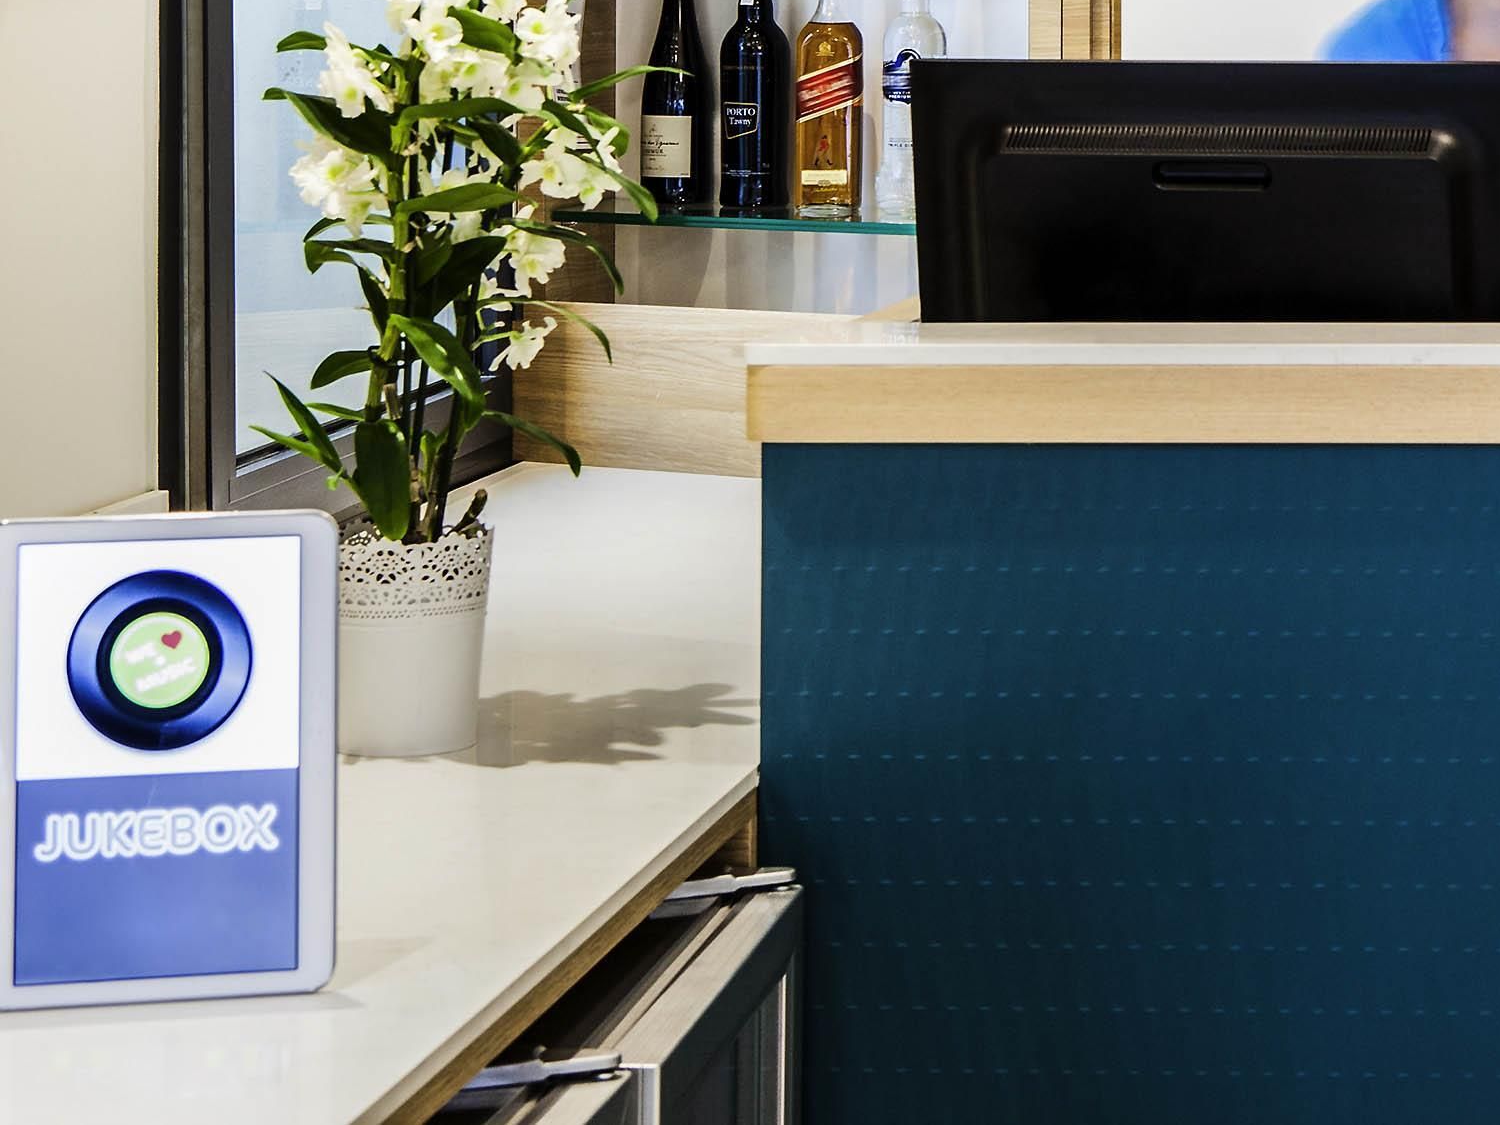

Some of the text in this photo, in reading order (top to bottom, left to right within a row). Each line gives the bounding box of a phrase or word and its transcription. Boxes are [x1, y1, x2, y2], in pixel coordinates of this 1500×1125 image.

[726, 108, 756, 116] PORTO
[729, 117, 752, 127] Tawny
[33, 803, 280, 862] JUKEBOX
